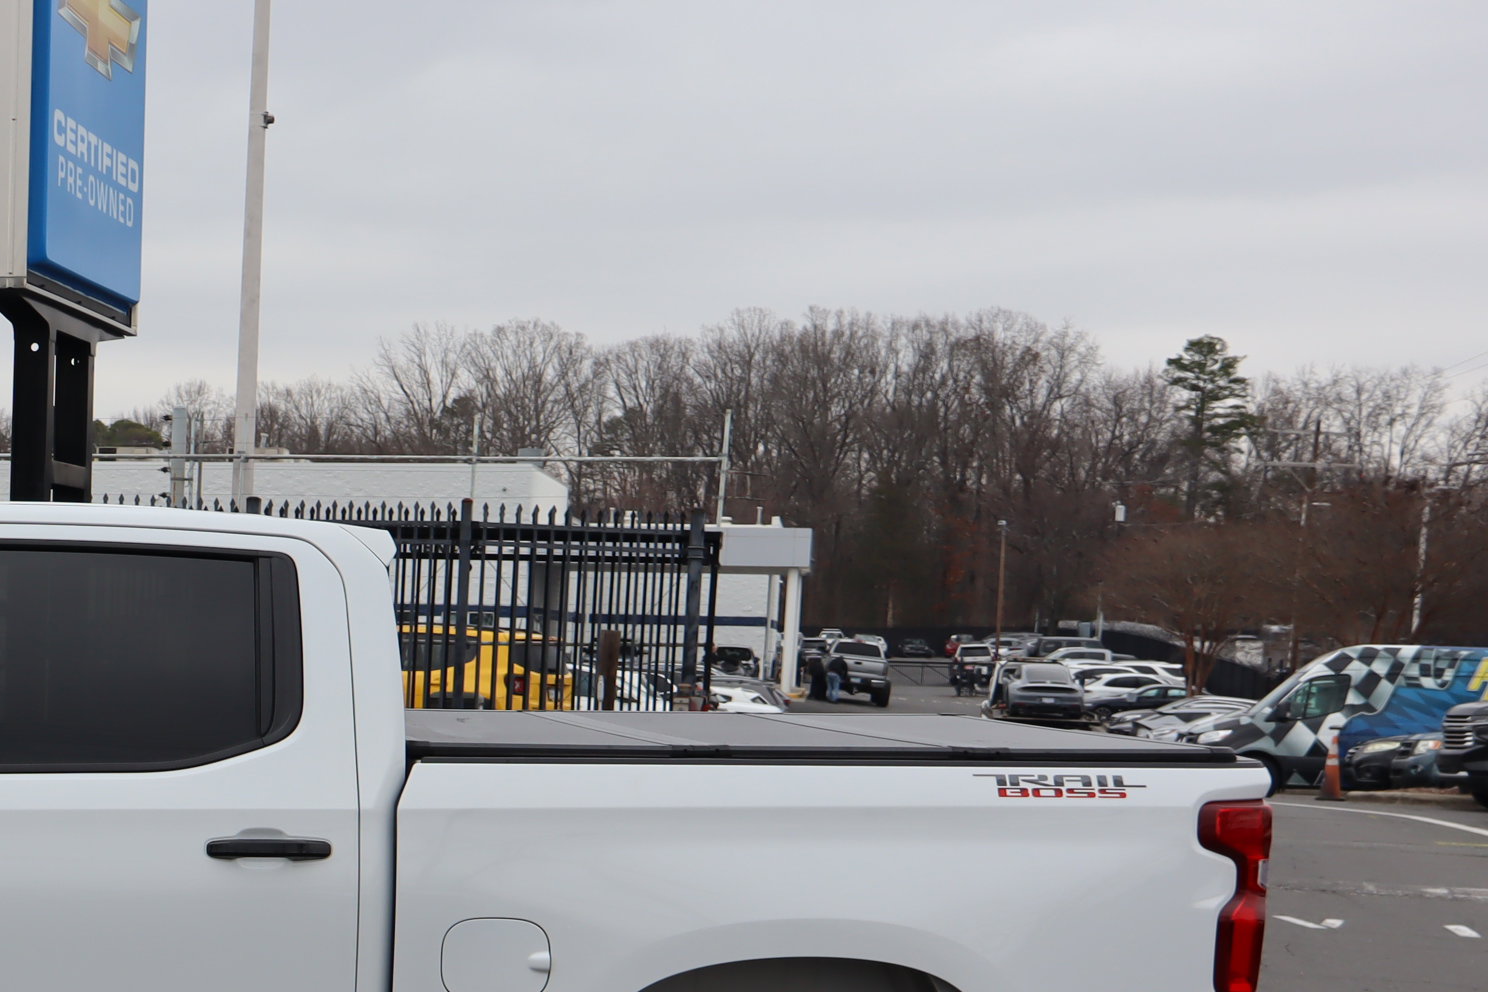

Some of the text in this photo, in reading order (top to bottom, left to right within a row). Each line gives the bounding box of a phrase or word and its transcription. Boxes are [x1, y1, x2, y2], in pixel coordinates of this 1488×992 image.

[53, 108, 139, 193] CERTIFIED
[57, 154, 134, 228] PRE-OWNED
[972, 774, 1148, 788] TRAIL
[997, 787, 1128, 799] BOSS
